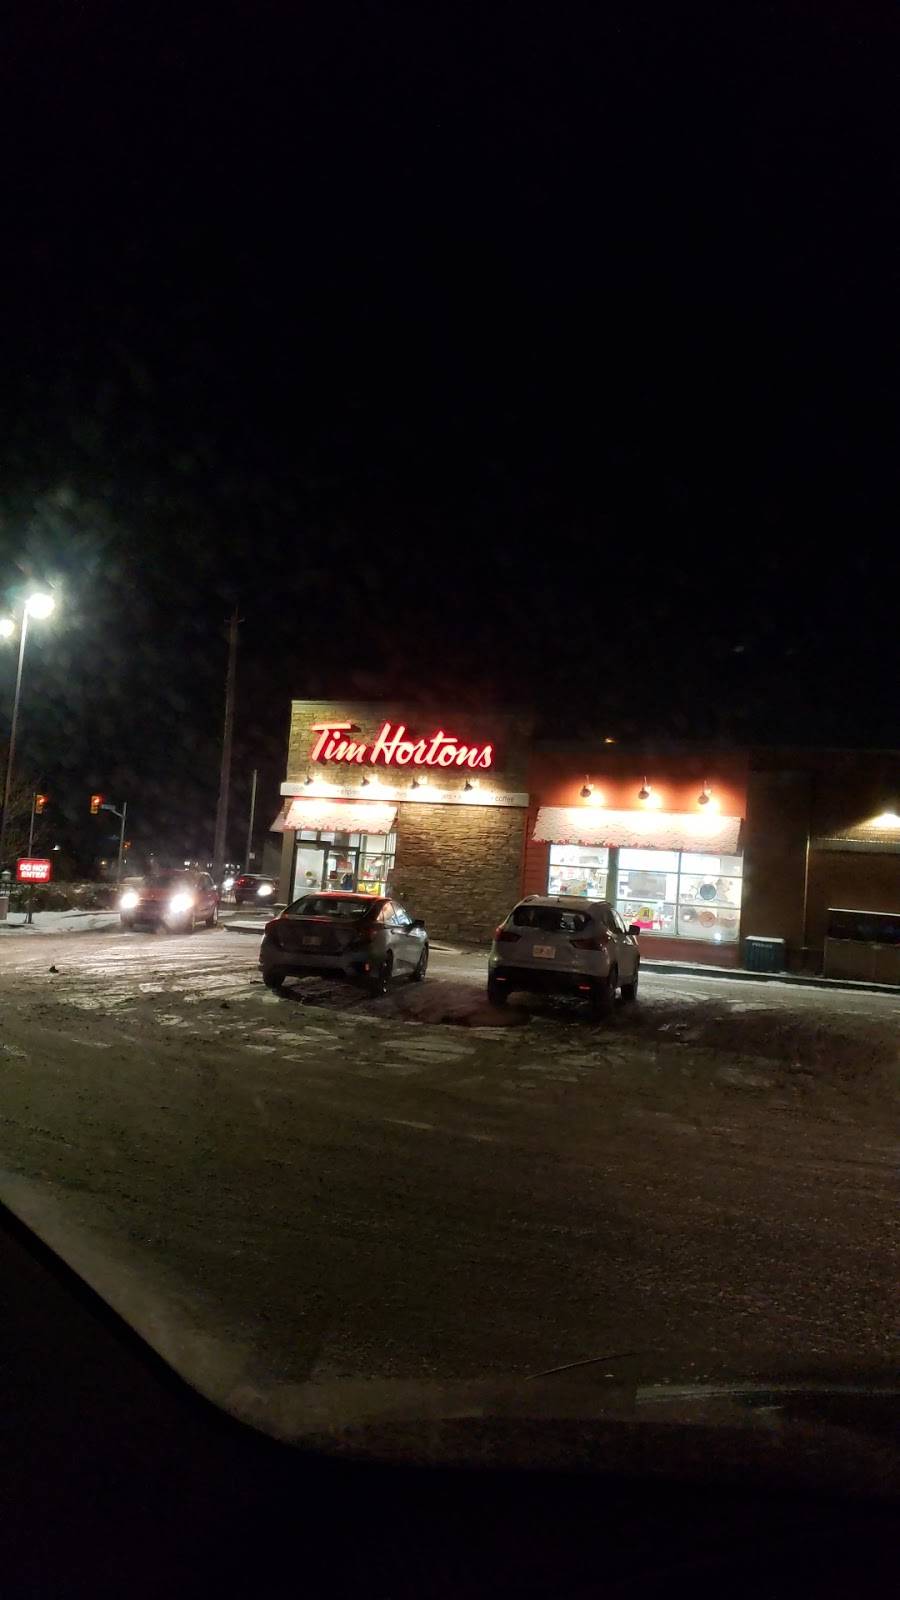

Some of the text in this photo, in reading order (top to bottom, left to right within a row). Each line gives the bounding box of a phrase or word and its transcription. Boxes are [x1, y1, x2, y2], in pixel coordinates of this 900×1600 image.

[311, 722, 493, 768] Tim Hortons
[20, 863, 48, 872] DO NOT
